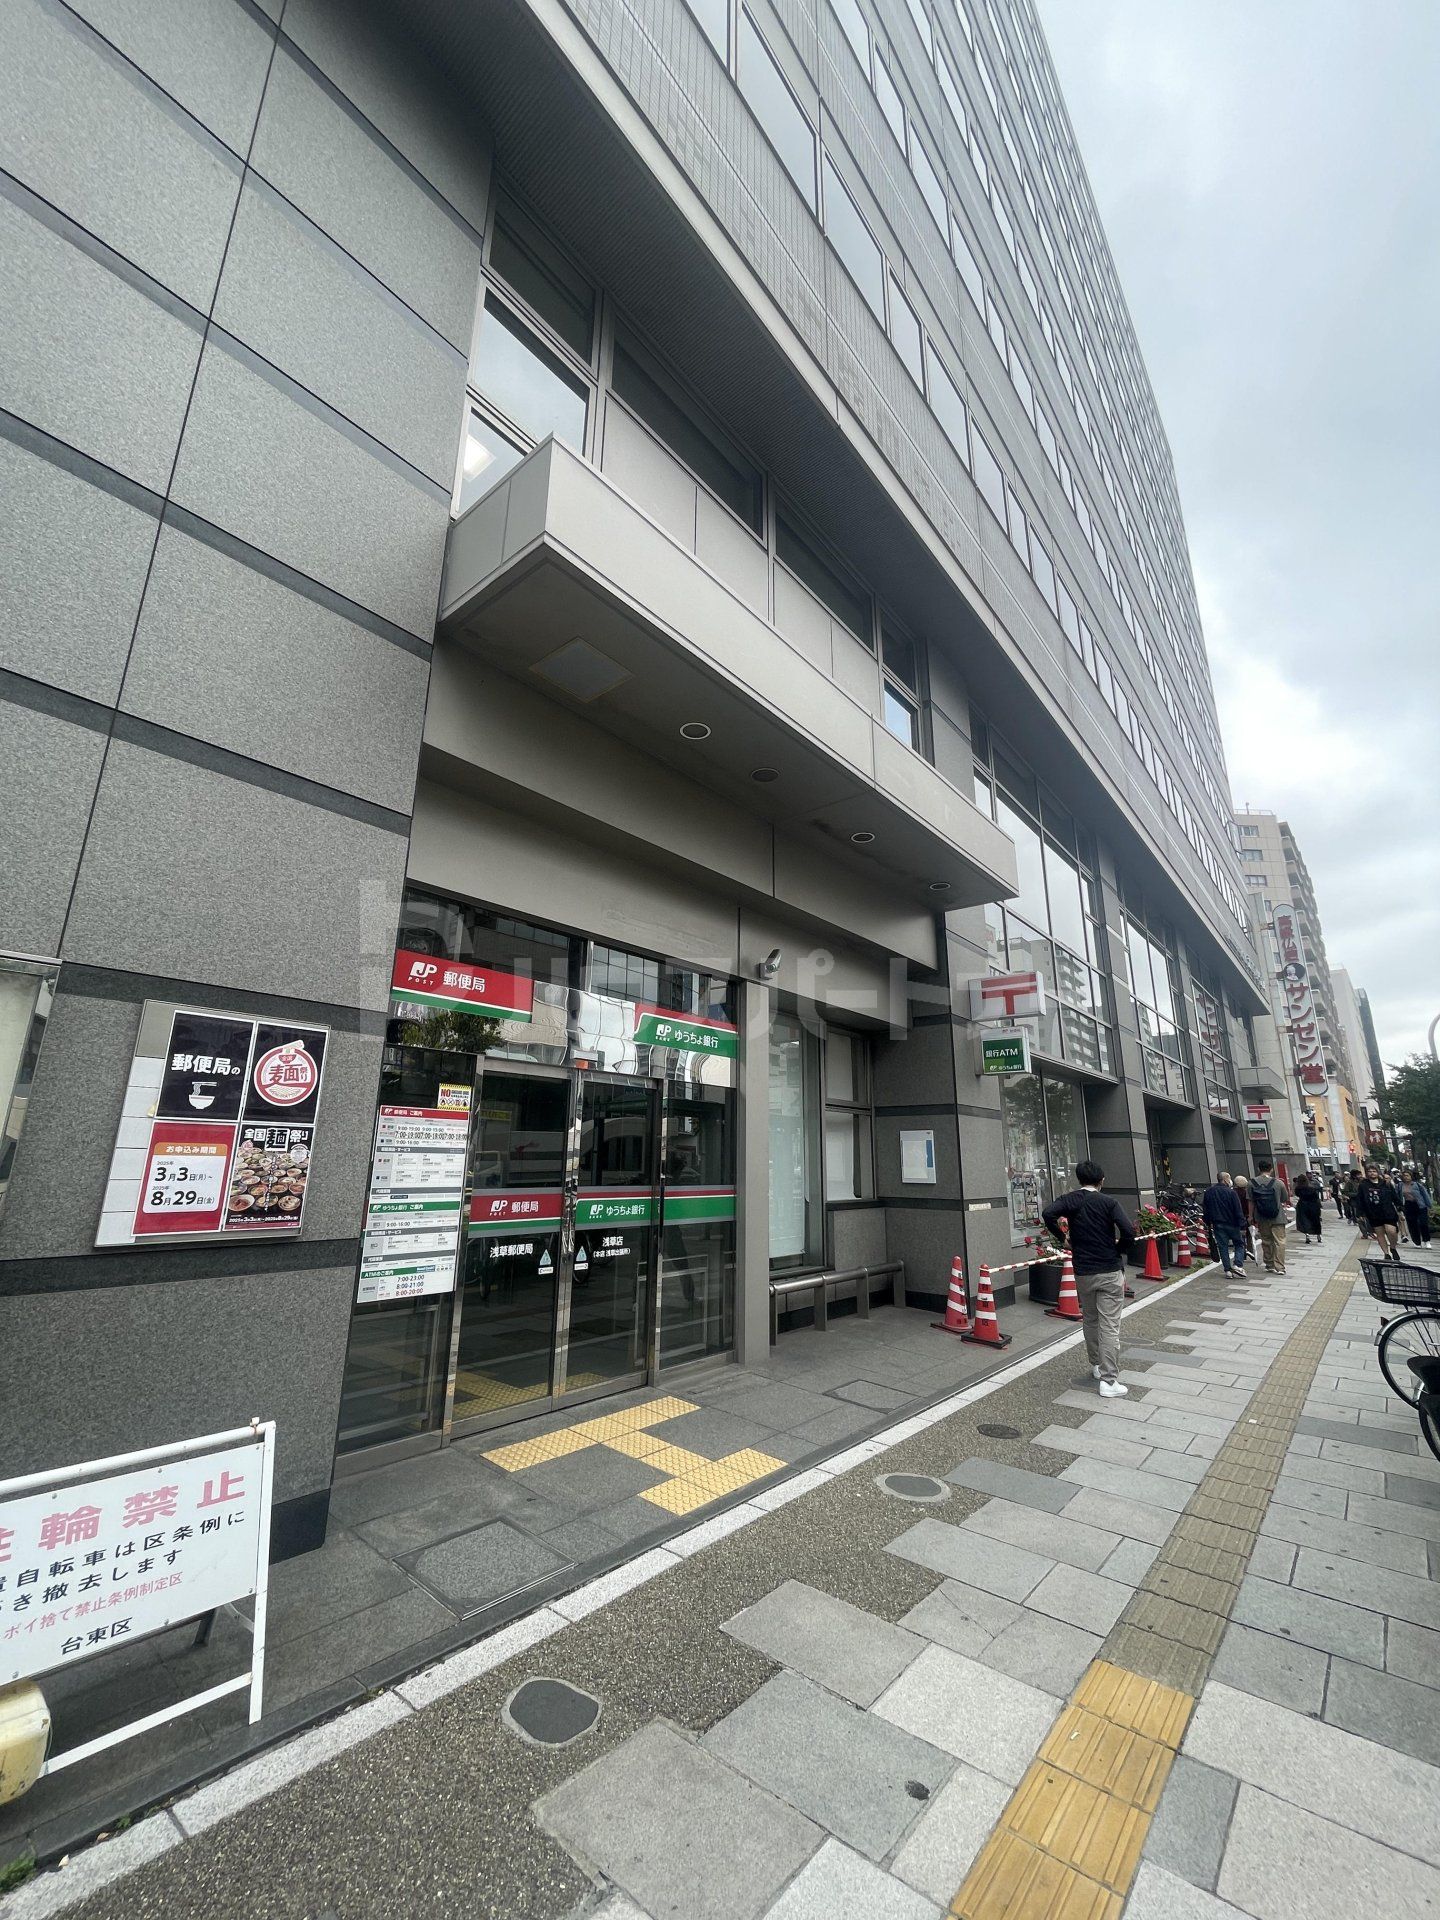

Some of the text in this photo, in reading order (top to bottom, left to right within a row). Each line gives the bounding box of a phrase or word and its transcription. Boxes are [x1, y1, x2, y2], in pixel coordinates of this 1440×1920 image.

[408, 976, 434, 986] POST
[410, 961, 486, 993] JP 郵便局
[656, 1024, 718, 1048] JP ゆうちょ銀行
[1286, 982, 1325, 1084] サンゼン堂
[986, 1048, 1018, 1057] 銀行ATM
[171, 1053, 241, 1076] 郵便局の
[441, 1089, 451, 1097] NO
[165, 1146, 217, 1154] お申込み期間
[150, 1191, 215, 1206] 8月29日(金)
[491, 1200, 538, 1213] JP 郵便局
[590, 1204, 645, 1216] JP ゆうちょ銀行
[602, 1236, 623, 1247] 浅草店
[490, 1243, 533, 1258] 浅草郵便局
[0, 1550, 183, 1612] き撤去します
[4, 1572, 183, 1640] ポイ捨て禁止条例制定区
[61, 1616, 133, 1655] 台東区
